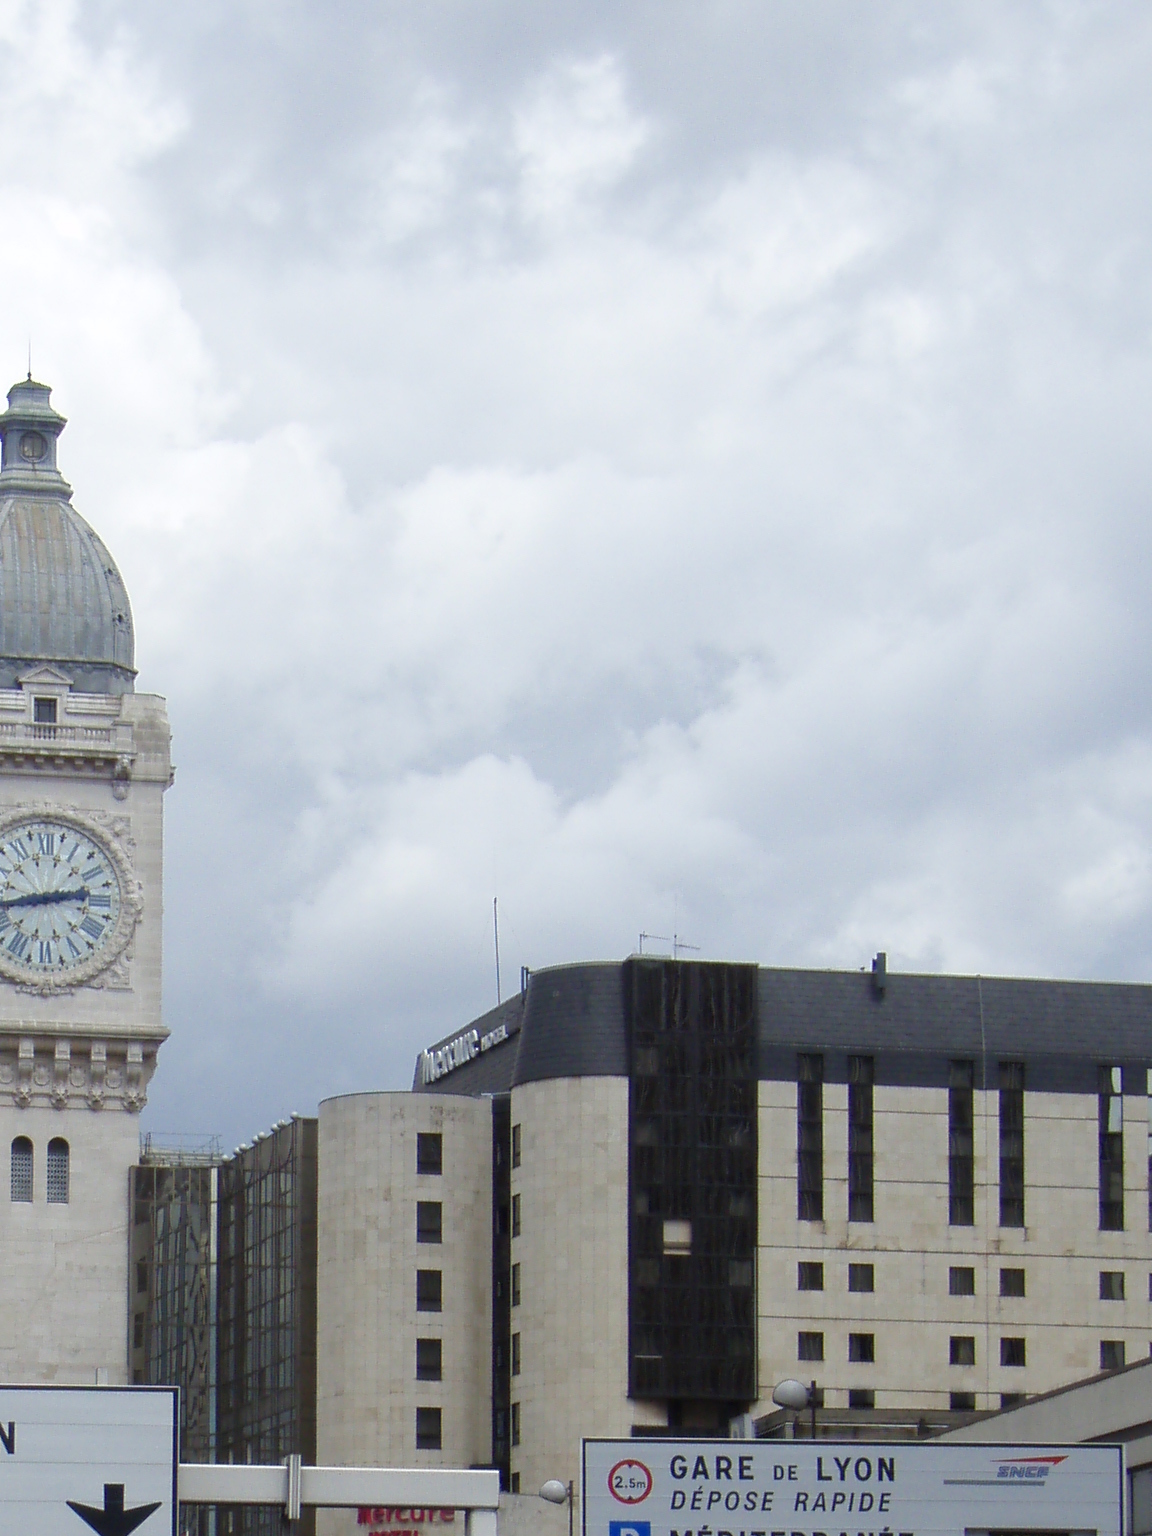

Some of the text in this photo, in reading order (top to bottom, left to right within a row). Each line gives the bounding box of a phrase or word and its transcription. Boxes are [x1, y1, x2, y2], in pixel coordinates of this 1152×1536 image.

[670, 1455, 895, 1481] GARE DE LYON
[997, 1466, 1049, 1478] SNCF
[615, 1476, 646, 1489] 2.5m
[671, 1486, 892, 1512] DÉPOSE RAPIDE
